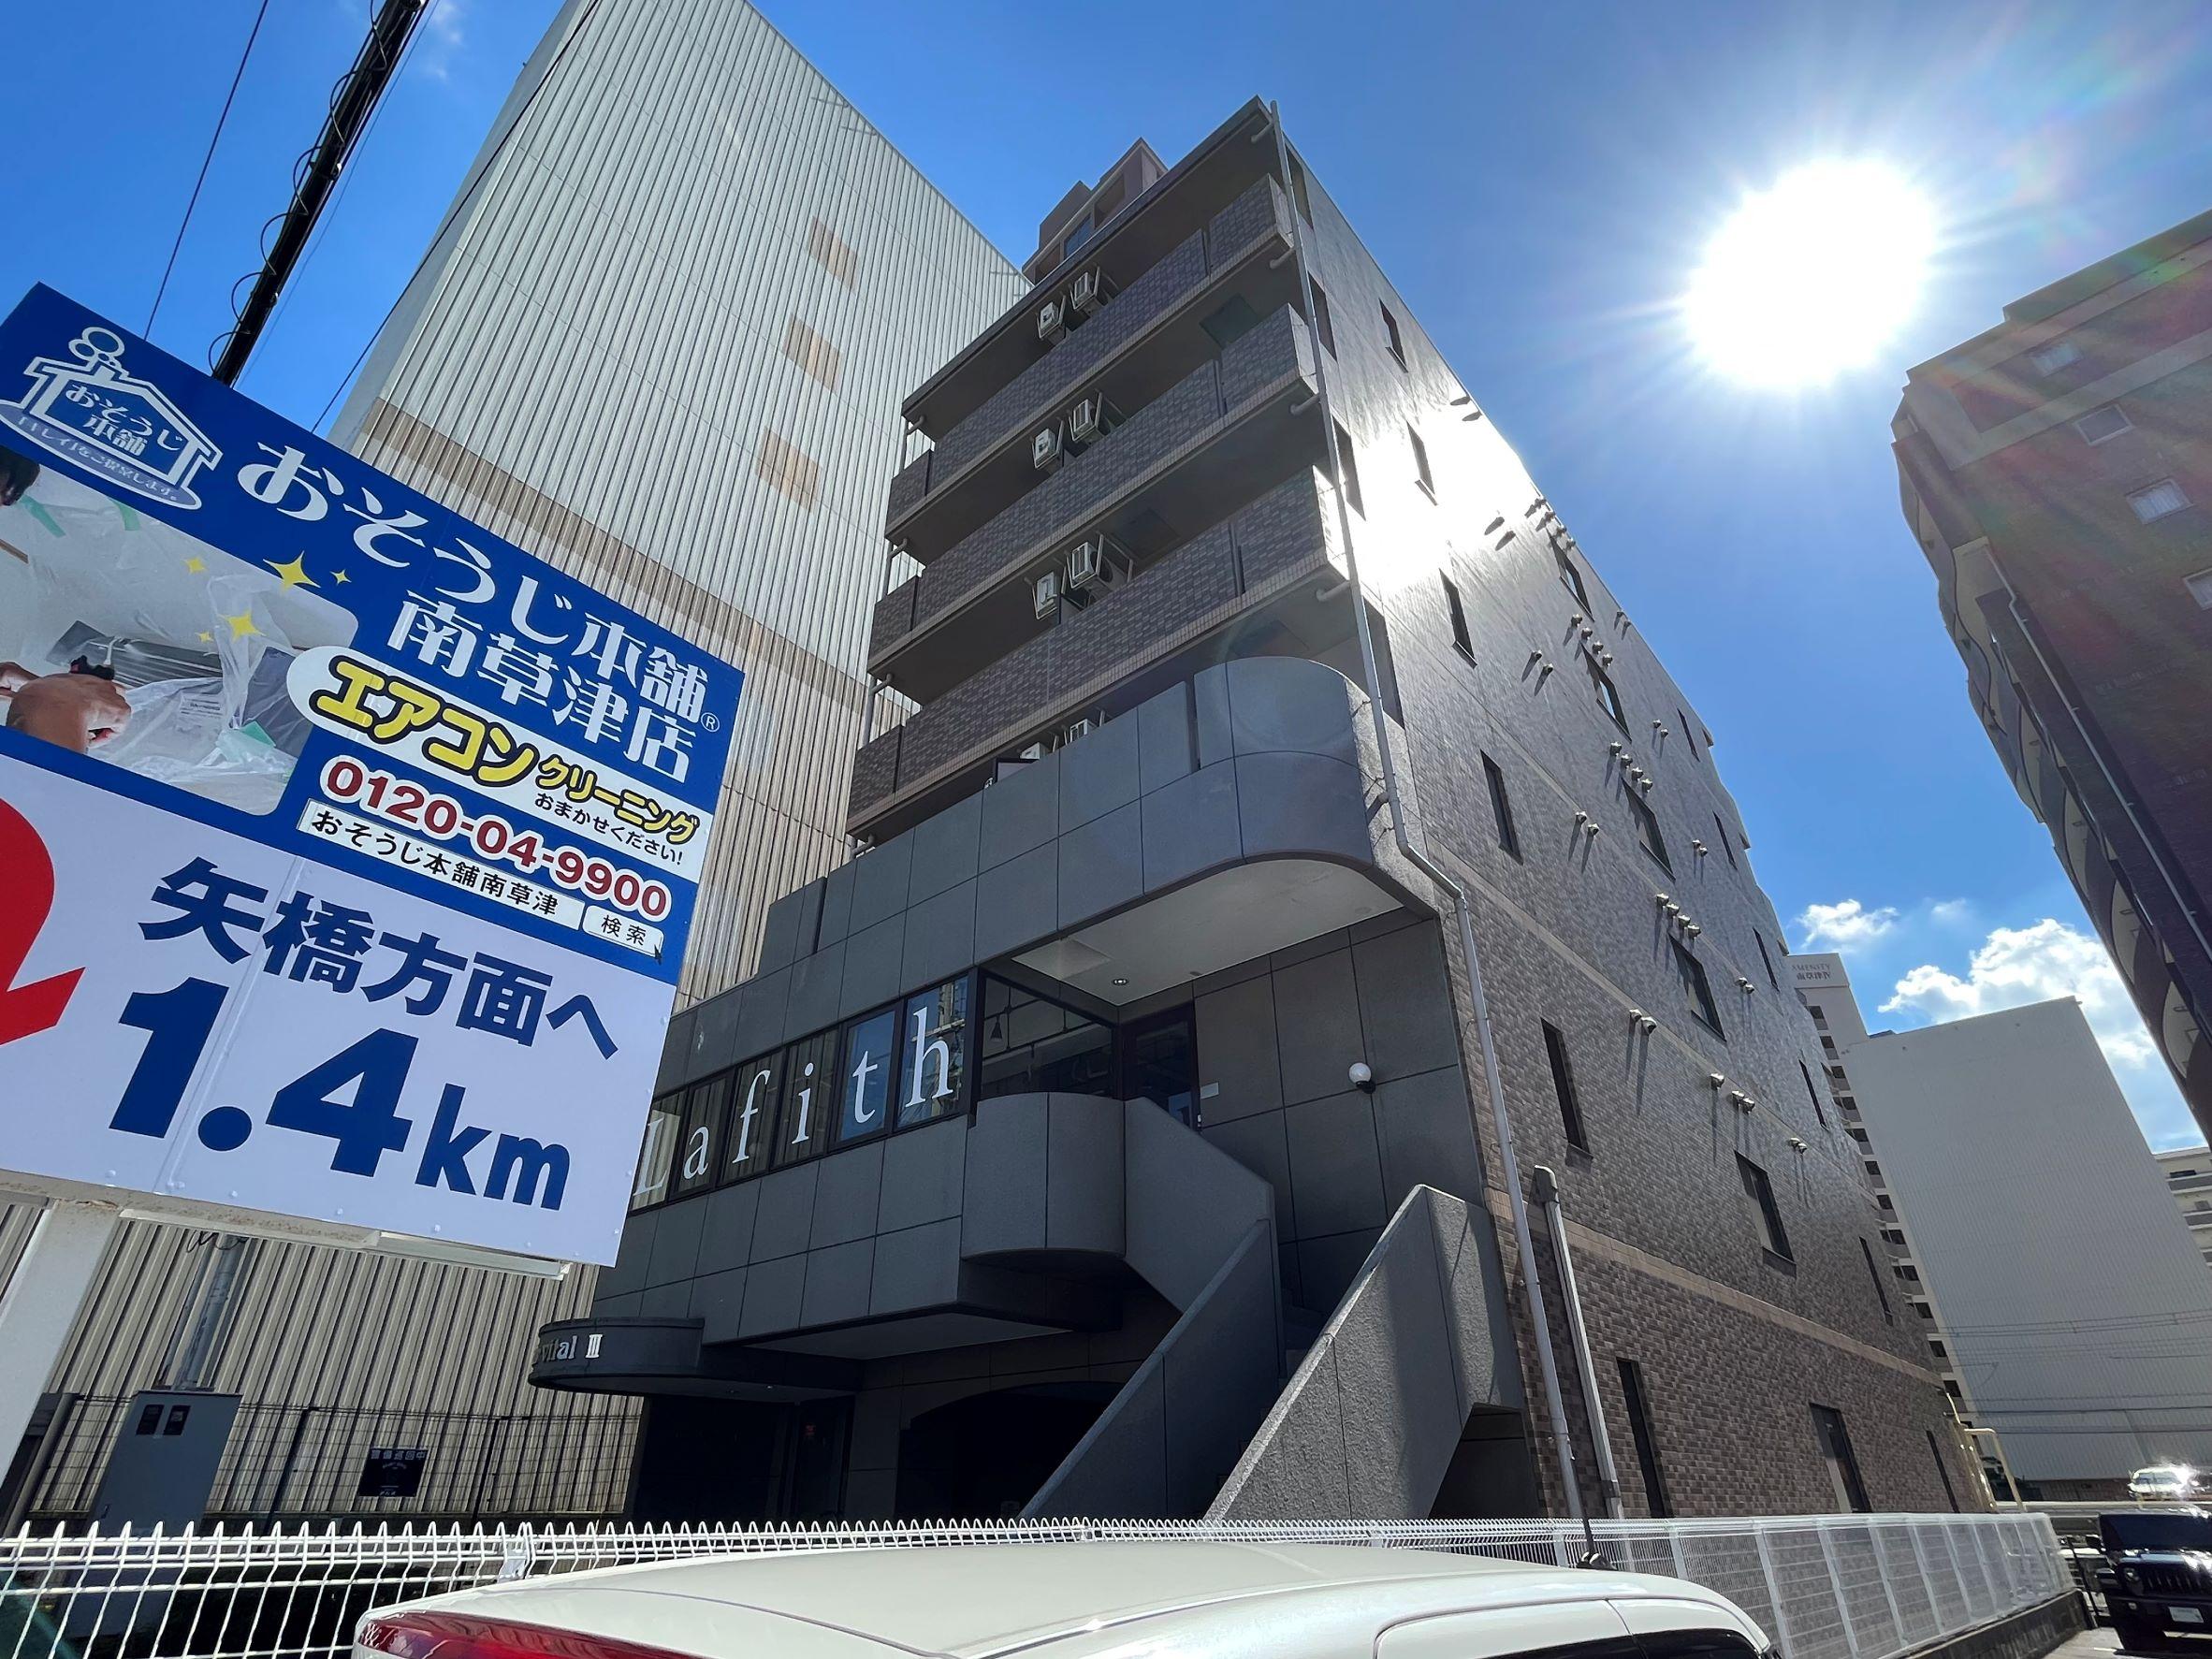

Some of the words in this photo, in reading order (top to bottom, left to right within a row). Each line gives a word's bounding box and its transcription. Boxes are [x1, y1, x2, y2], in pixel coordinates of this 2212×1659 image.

[65, 384, 183, 451] おそうじ
[83, 414, 149, 457] 本舗
[386, 589, 696, 784] 南草津店
[311, 809, 559, 916] おそうじ本舗南草津
[324, 758, 669, 919] 0120-04-9900
[534, 793, 683, 866] おまかせください!
[138, 854, 619, 1061] 矢橋方面へ
[600, 914, 648, 946] 検索
